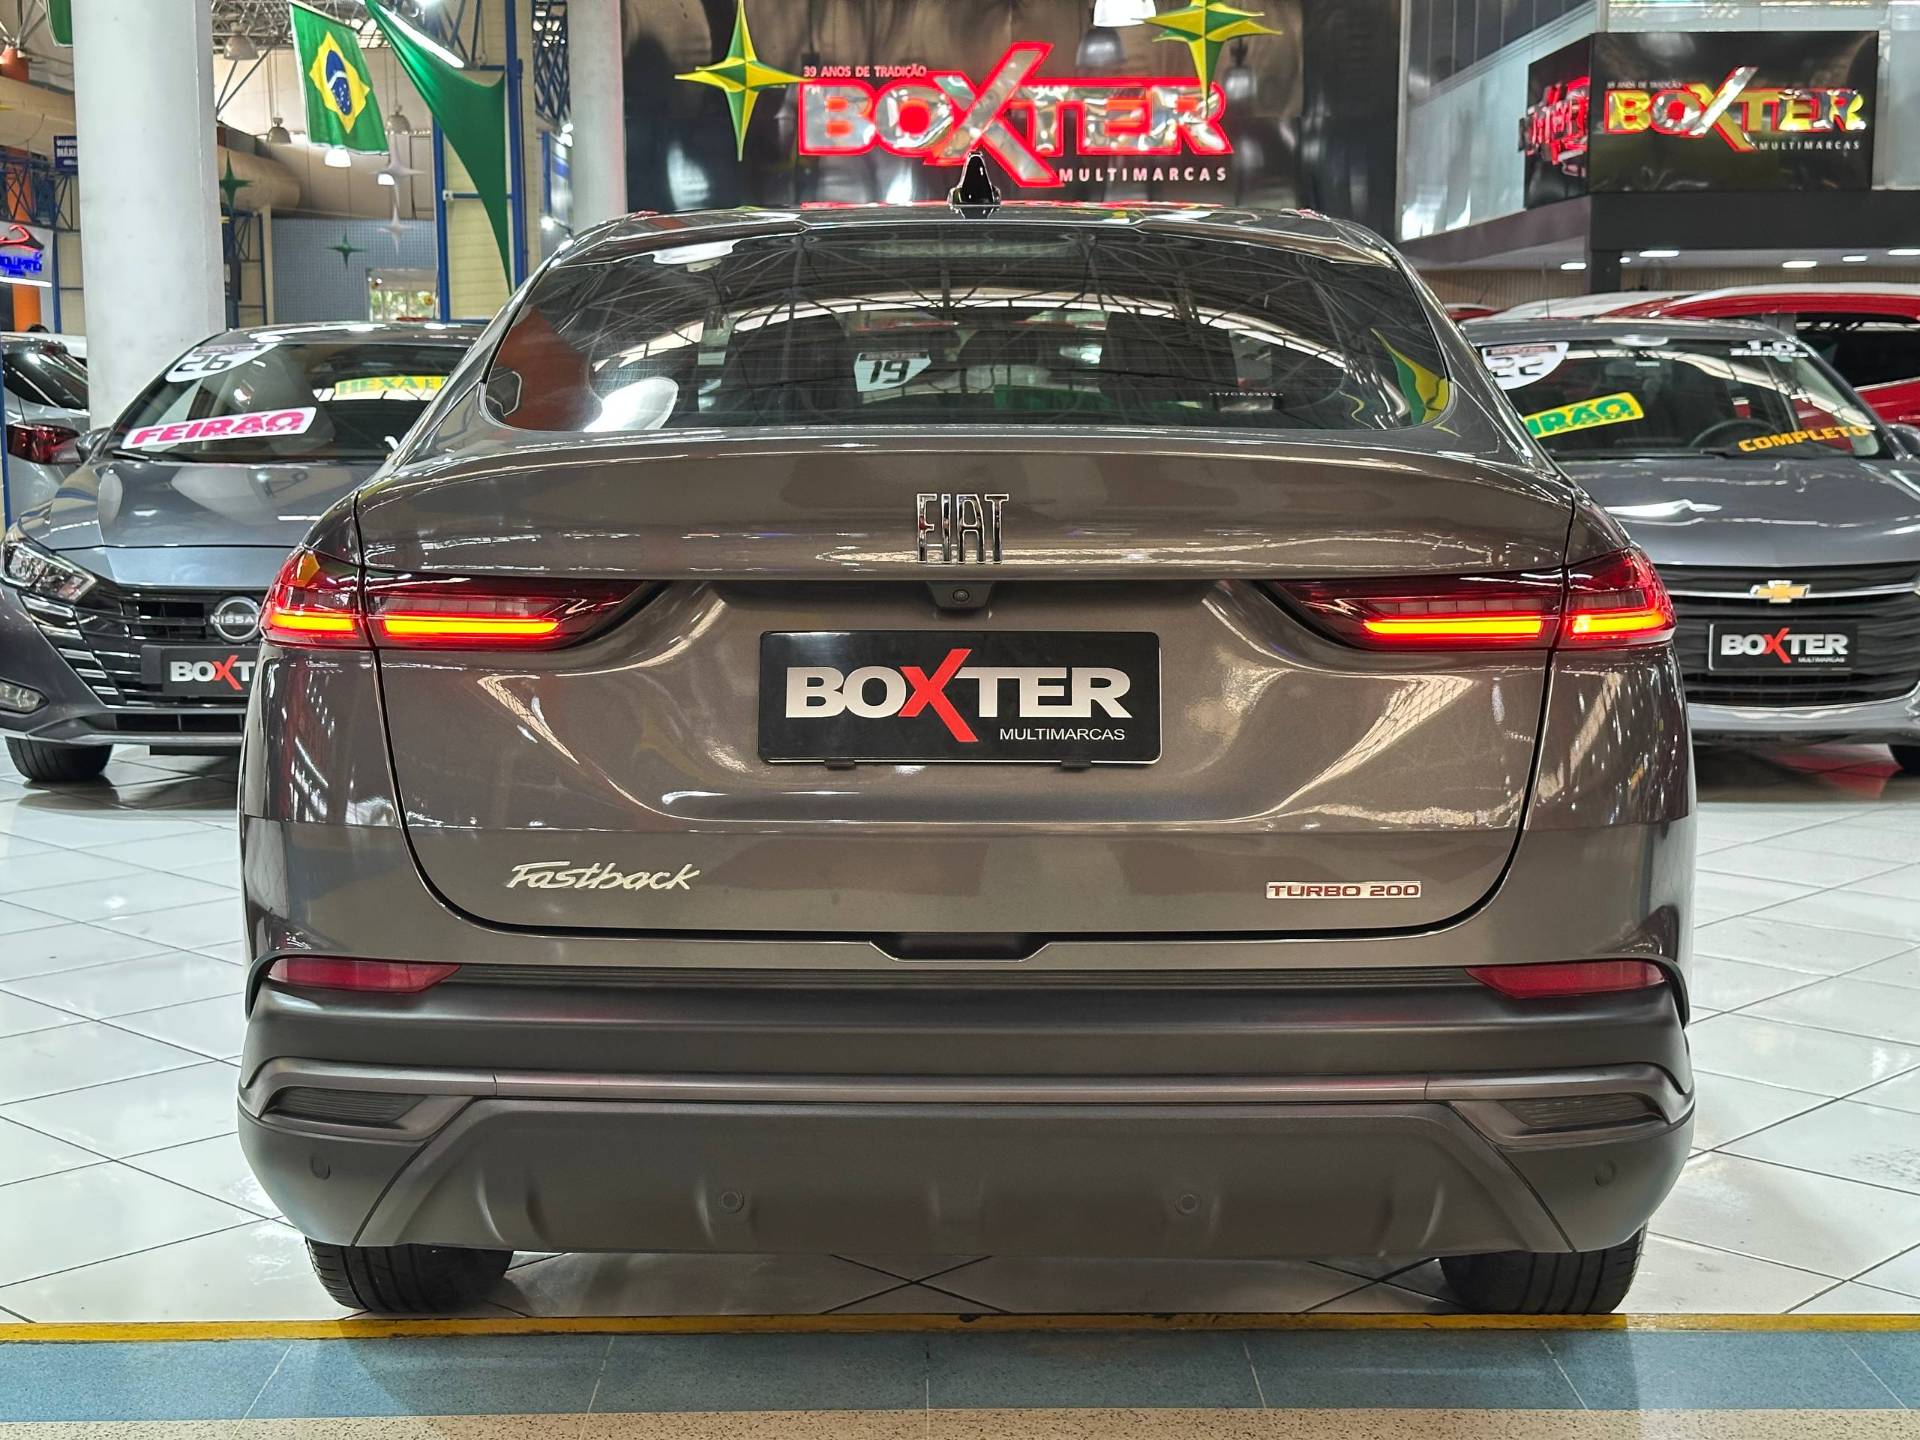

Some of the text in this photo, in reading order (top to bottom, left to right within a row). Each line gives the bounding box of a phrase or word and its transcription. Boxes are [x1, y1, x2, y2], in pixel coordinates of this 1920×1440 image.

[803, 63, 927, 78] 39 ANOS DE TRADIÇÃO
[798, 41, 1233, 188] BOXTER
[1603, 65, 1867, 153] BOXTER
[1759, 141, 1860, 150] MULTIMARCAS
[1059, 167, 1226, 182] MULTIMARCAS
[175, 354, 232, 372] 26
[870, 360, 910, 384] 19
[132, 411, 305, 445] FEIRÃO
[1738, 426, 1869, 452] COMPLETO
[916, 493, 1009, 565] FIAT
[1720, 627, 1848, 664] BOXTER
[785, 648, 1133, 743] BOXTER
[1000, 728, 1125, 741] MULTIMARCAS
[506, 861, 700, 891] Fastback
[1269, 885, 1420, 897] TURBO 200
